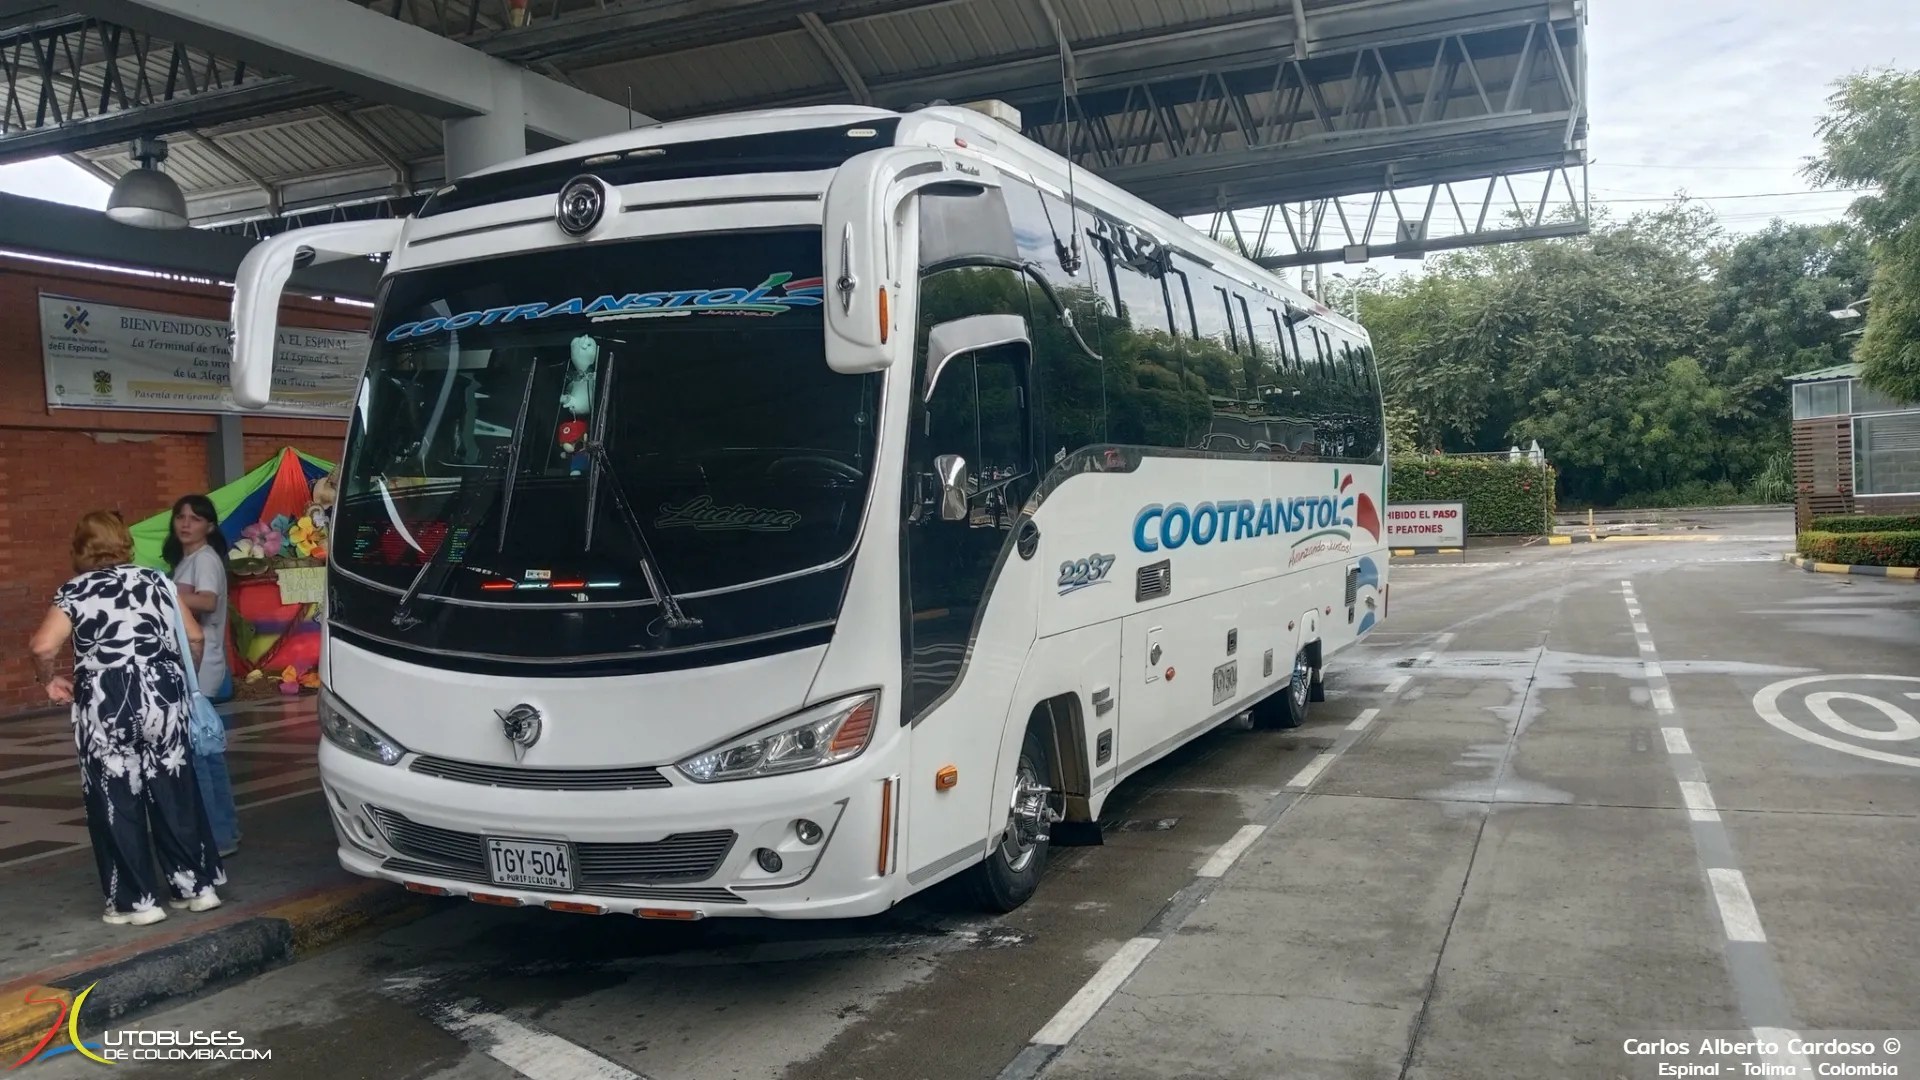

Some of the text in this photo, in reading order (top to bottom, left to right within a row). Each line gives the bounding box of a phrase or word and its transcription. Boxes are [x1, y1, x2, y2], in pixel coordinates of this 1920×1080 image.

[386, 286, 778, 342] COOTRANSTOL
[120, 316, 212, 338] BIENVENIDOS
[289, 335, 302, 346] EL
[305, 336, 350, 351] ESPINAL
[131, 337, 144, 348] La
[148, 338, 194, 353] Terminal
[196, 344, 208, 353] de
[193, 357, 209, 367] Los
[173, 367, 186, 378] de
[187, 369, 197, 379] la
[1388, 509, 1457, 520] HIBIDO EL PASO
[1133, 494, 1343, 553] COOTRANSTOL
[1396, 524, 1443, 534] PEATONES
[1057, 552, 1117, 588] 2237
[506, 873, 558, 886] PURIFICACION
